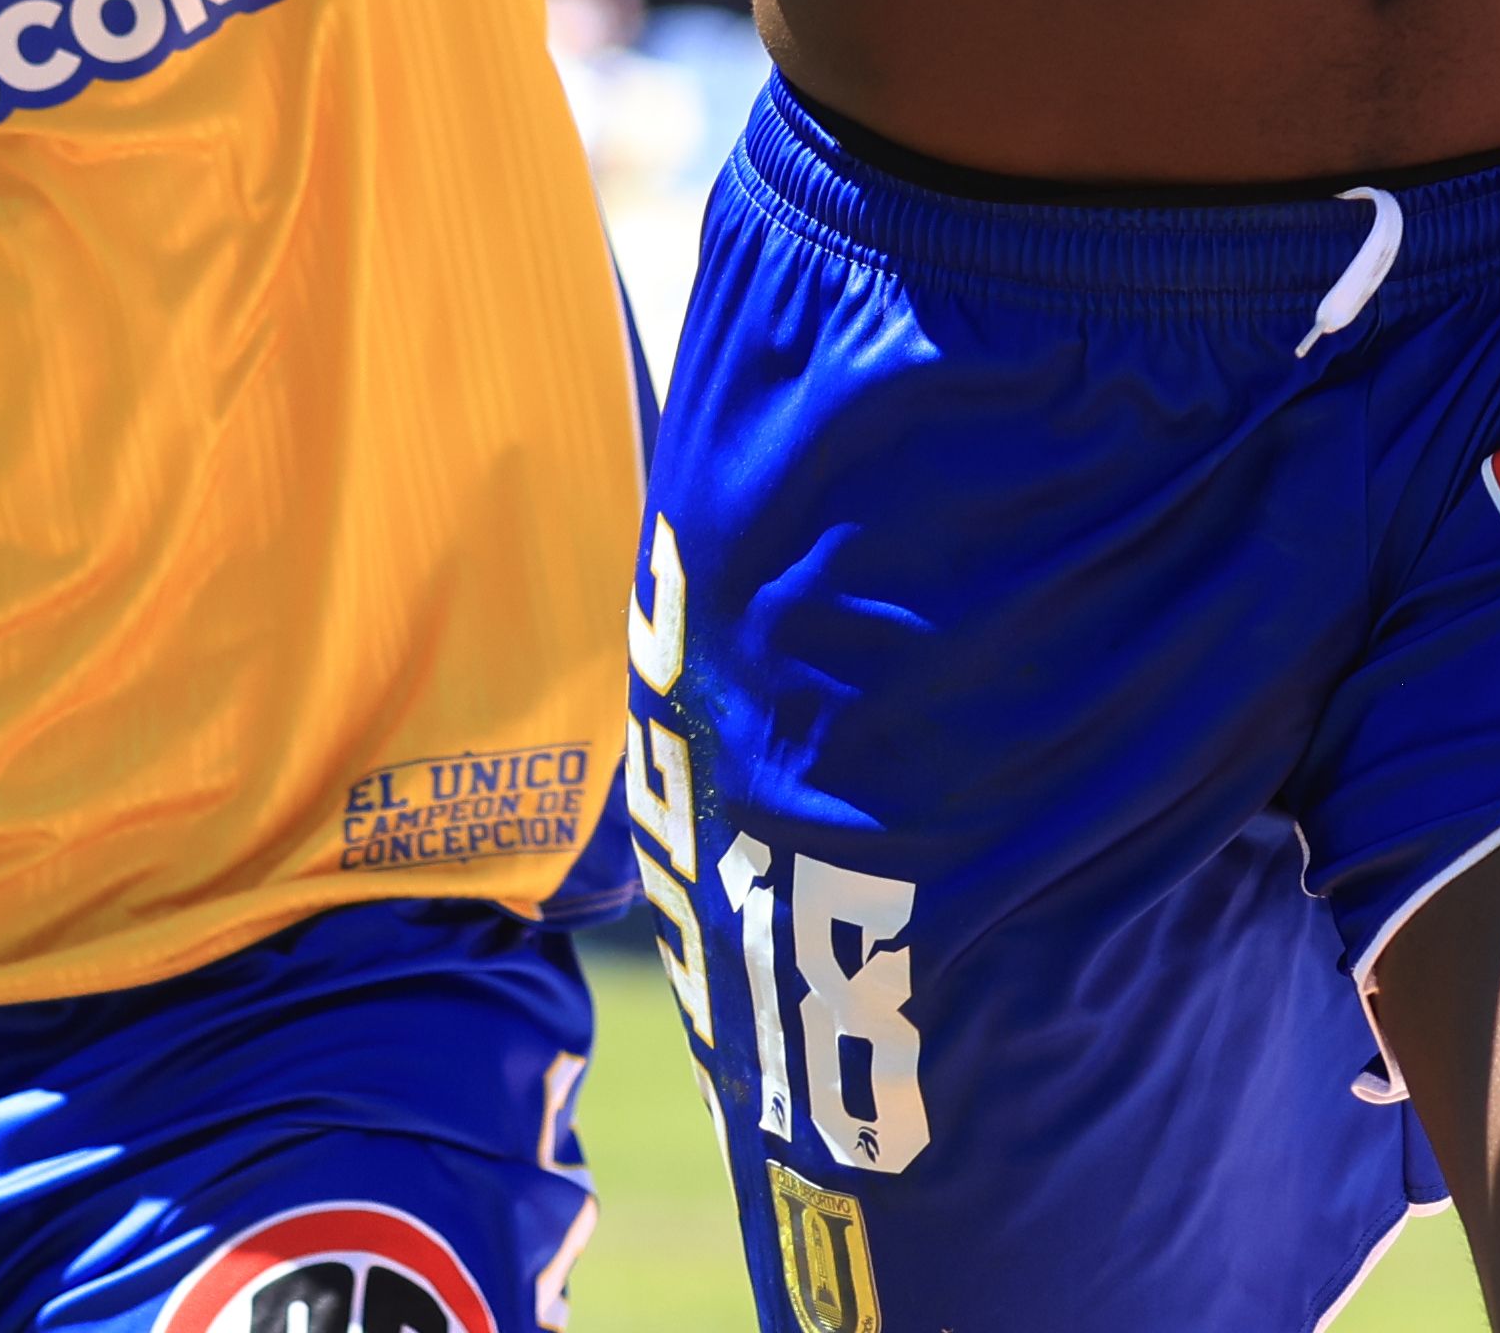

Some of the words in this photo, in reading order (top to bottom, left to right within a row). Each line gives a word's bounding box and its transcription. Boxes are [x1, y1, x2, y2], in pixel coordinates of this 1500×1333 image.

[343, 793, 522, 844] CAMPEON
[537, 789, 584, 815] DE
[345, 773, 409, 814] EL
[340, 817, 579, 871] CONCEPCION
[717, 831, 930, 1175] 18
